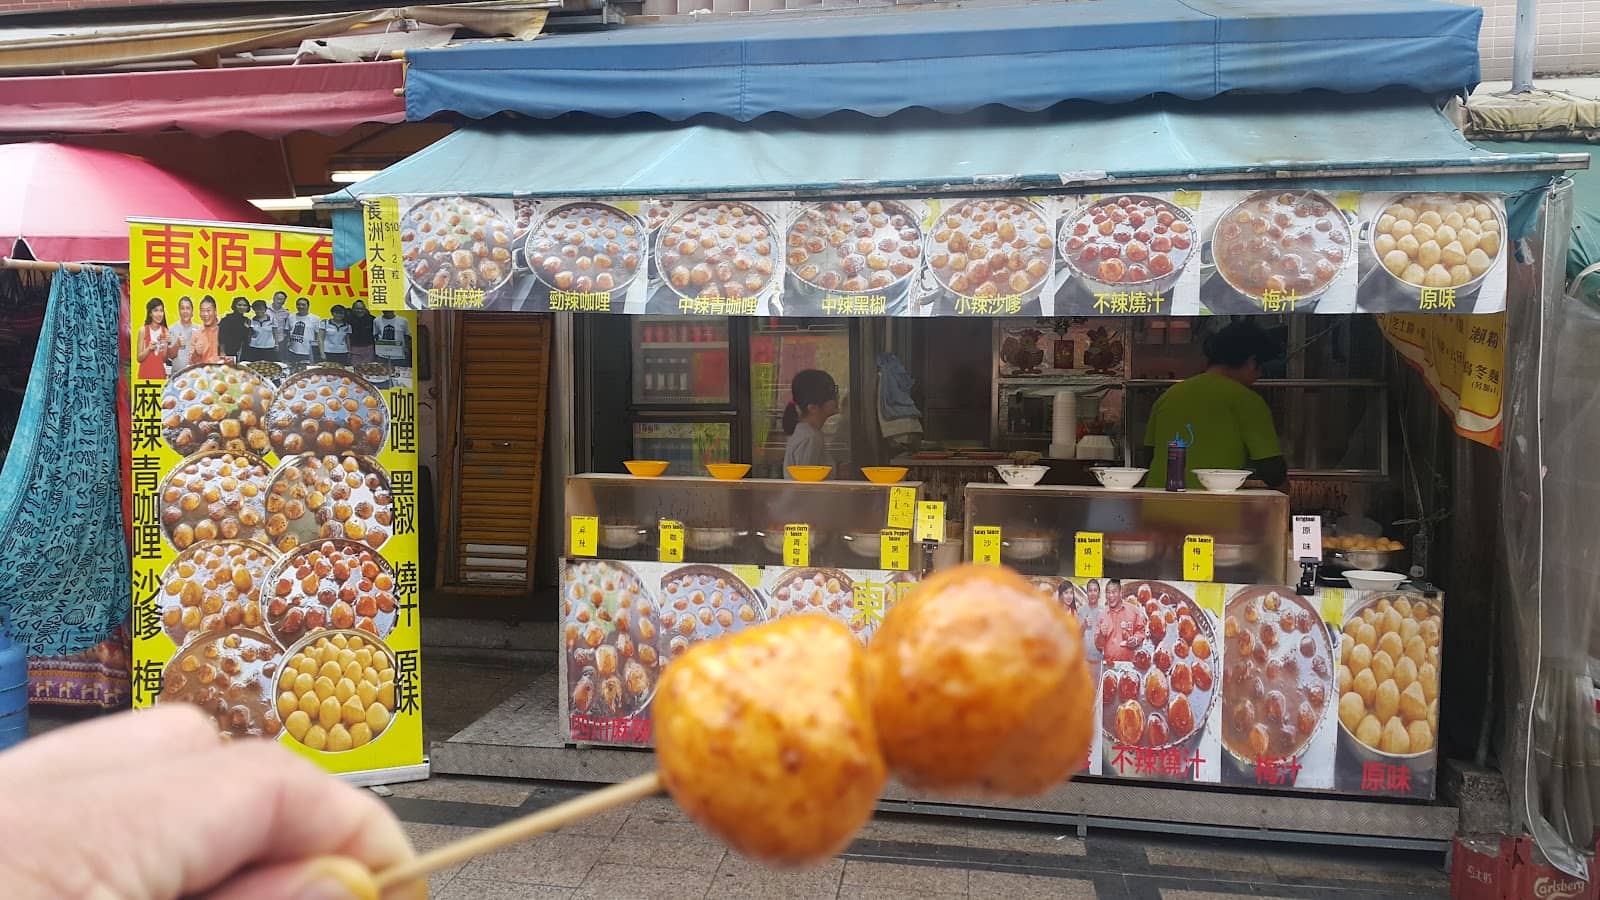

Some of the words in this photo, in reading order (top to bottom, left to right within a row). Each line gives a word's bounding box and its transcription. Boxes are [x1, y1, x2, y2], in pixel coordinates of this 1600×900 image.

[142, 225, 368, 297] 東源大魚
[367, 200, 388, 304] 長洲大魚蛋
[428, 288, 484, 308] 四川麻辣
[549, 291, 610, 311] 勁辣咖哩
[678, 295, 758, 314] 中辣青咖哩
[821, 295, 886, 314] 中辣黑椒
[954, 294, 1021, 314] 小辣沙嗲
[1093, 291, 1165, 313] 不辣燒汁
[1262, 289, 1296, 311] 梅汁
[1419, 288, 1456, 311] 原味
[132, 380, 162, 451] 麻辣
[390, 389, 416, 453] 咖哩
[132, 454, 162, 559] 青咖哩
[390, 470, 415, 536] 黑椒
[133, 568, 163, 641] 沙嗲
[392, 561, 418, 628] 燒汁
[394, 650, 419, 716] 原味
[1111, 745, 1206, 780] 不辣燒汁
[1255, 751, 1303, 785] 梅汁
[1361, 761, 1412, 794] 原味
[1533, 876, 1586, 900] Carlsberg
